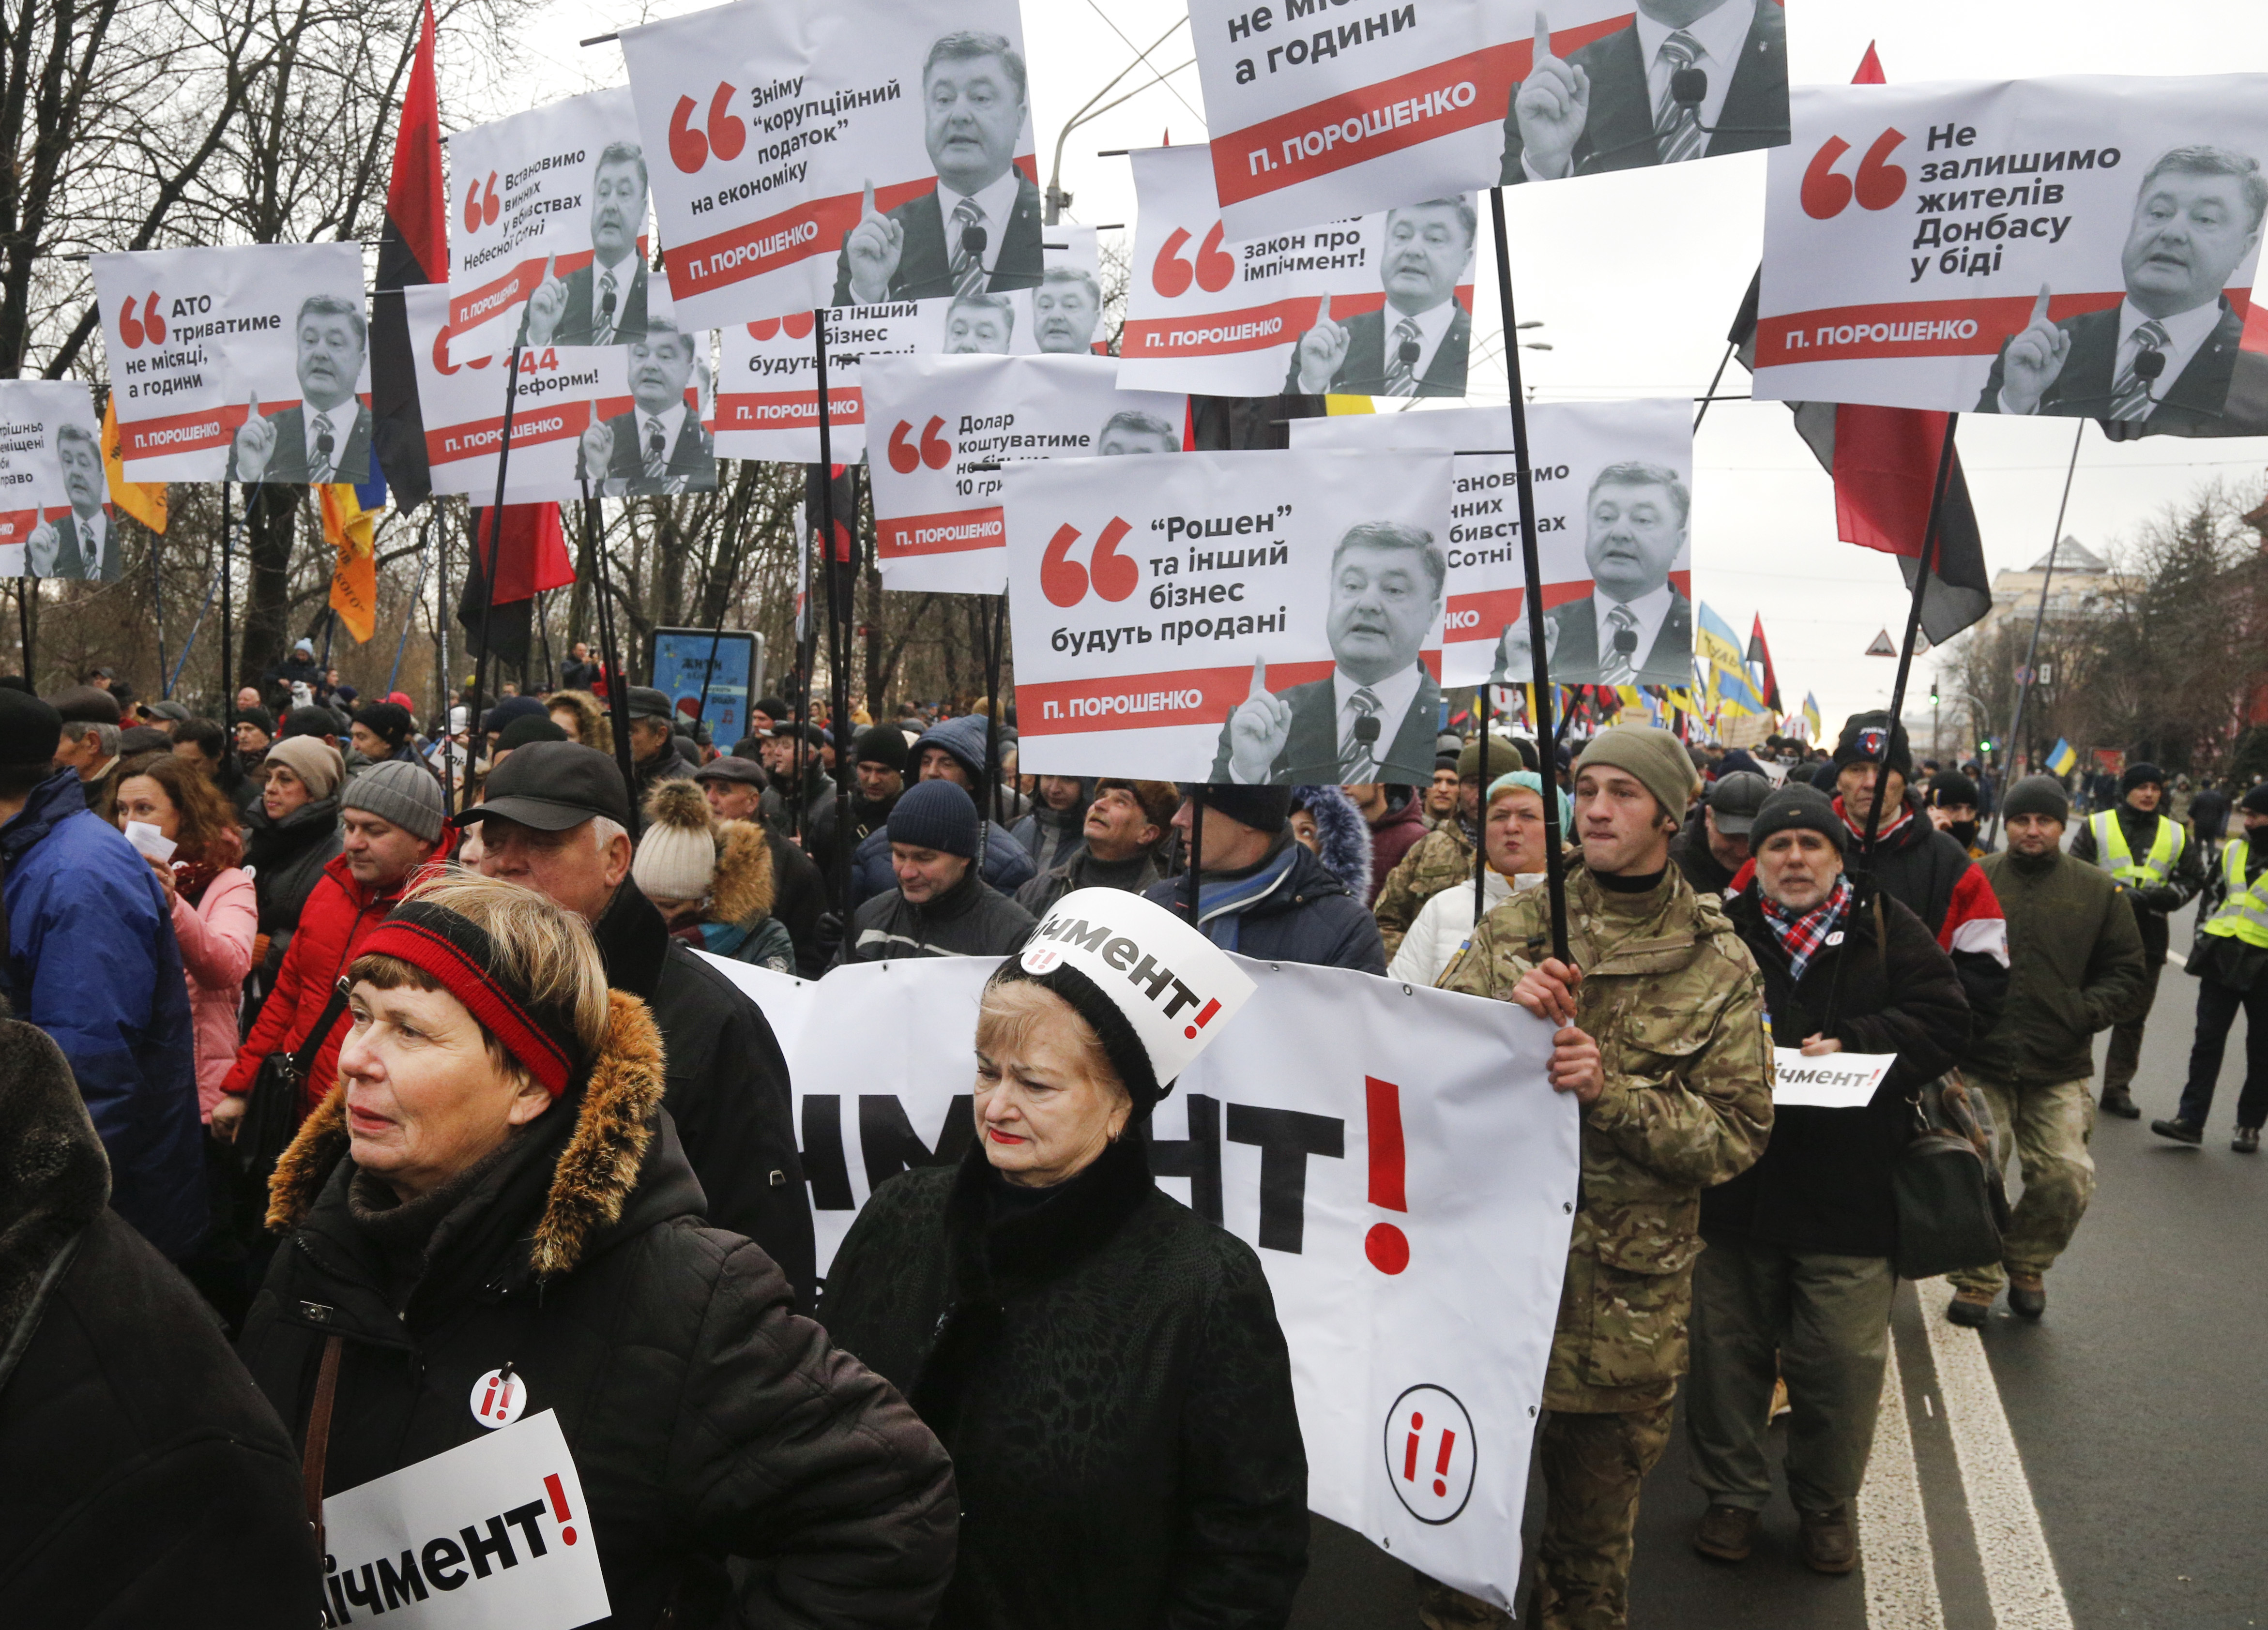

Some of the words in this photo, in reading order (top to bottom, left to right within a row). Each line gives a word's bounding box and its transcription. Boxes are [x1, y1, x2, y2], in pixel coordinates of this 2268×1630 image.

[1228, 6, 1273, 43] не
[1235, 59, 1256, 85] а
[1266, 3, 1416, 74] години
[751, 76, 805, 109] Зніму
[753, 79, 901, 134] “корупційний
[758, 118, 850, 165] податок”
[1248, 148, 1279, 176] П.
[1283, 81, 1476, 166] ПОРОШЕНКО
[1926, 122, 1977, 152] Не
[506, 150, 585, 191] Встановимо
[1920, 147, 2121, 183] залишимо
[504, 181, 541, 212] винних
[691, 190, 714, 215] на
[719, 160, 808, 208] економіку
[1916, 178, 2064, 214] жителів
[503, 221, 510, 238] у
[1244, 235, 1305, 259] закон
[1314, 231, 1360, 251] про
[1912, 214, 2072, 249] Донбасу
[464, 234, 514, 271] Небесної
[689, 259, 708, 280] П.
[710, 220, 819, 273] ПОРОШЕНКО
[1244, 248, 1365, 282] імпічмент!
[1910, 255, 1931, 283] у
[1939, 244, 2003, 277] біді
[172, 295, 211, 317] АТО
[460, 308, 469, 322] П.
[470, 278, 519, 317] ПОРОШЕНКО
[850, 300, 917, 320] інший
[173, 315, 281, 345] триватиме
[824, 327, 888, 345] бізнес
[1145, 333, 1164, 347] П.
[1169, 317, 1283, 346] ПОРОШЕНКО
[1785, 329, 1810, 350] П.
[1816, 318, 1979, 347] ПОРОШЕНКО
[126, 359, 146, 375] не
[152, 345, 208, 370] місяці,
[129, 383, 138, 398] а
[144, 374, 203, 396] години
[514, 369, 599, 396] еформи!
[736, 406, 752, 420] П.
[757, 400, 859, 420] ПОРОШНКО
[959, 413, 1015, 435] Долар
[135, 434, 147, 448] П.
[150, 422, 220, 446] ПОРОШЕНКО
[445, 438, 461, 452] П.
[959, 434, 1091, 454] коштуватиме
[956, 479, 973, 496] 10
[1453, 465, 1569, 493] ановмо
[896, 531, 912, 546] П.
[915, 520, 1003, 544] ПОРОШЕНКО
[1150, 505, 1292, 542] “Рошен”
[1449, 516, 1567, 543] бивстах
[1150, 555, 1180, 577] та
[1189, 541, 1289, 574] інший
[1448, 542, 1512, 569] Сотні
[1149, 582, 1245, 610] бізнес
[1051, 627, 1153, 657] будуть
[1161, 606, 1286, 646] продані
[1043, 700, 1065, 720] П.
[1069, 688, 1202, 717] ПОРОШЕНКО
[1020, 913, 1222, 1040] ічмент!
